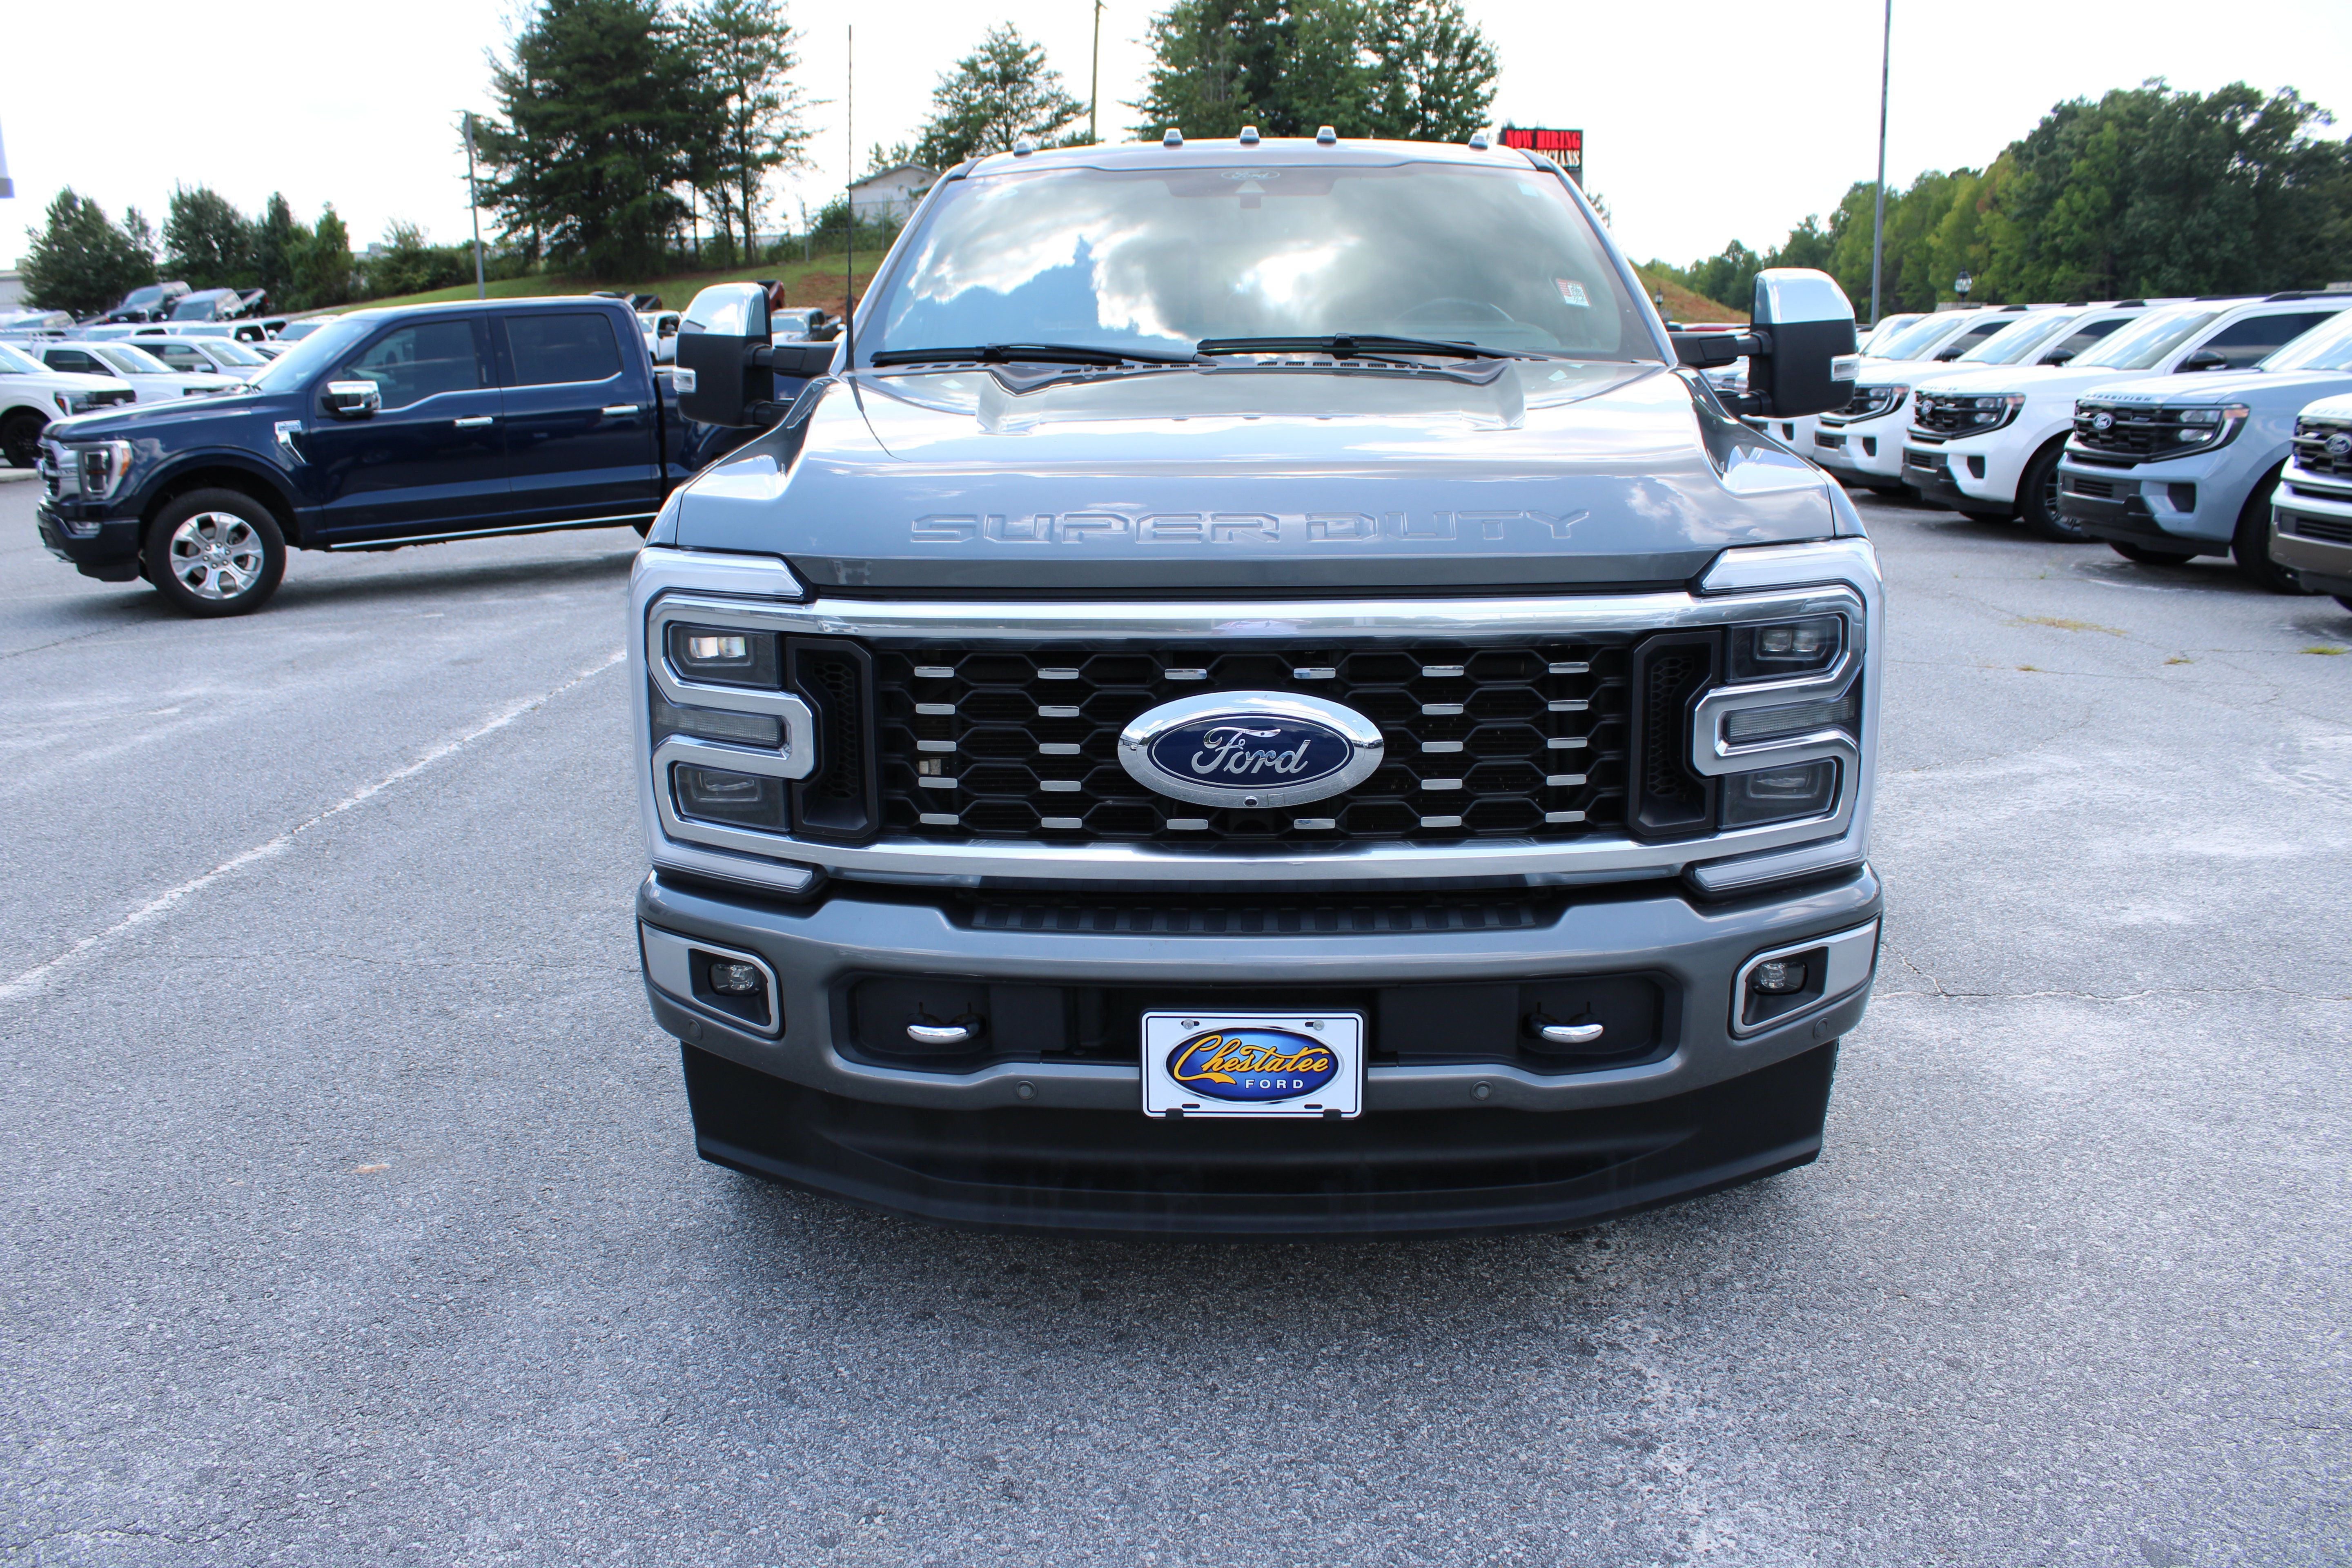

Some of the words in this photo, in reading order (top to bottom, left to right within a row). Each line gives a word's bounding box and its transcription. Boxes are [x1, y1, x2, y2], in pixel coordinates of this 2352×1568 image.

[1506, 130, 1534, 148] NOW
[1537, 130, 1580, 149] HIRING
[911, 513, 1281, 544] SUPER
[1305, 510, 1590, 542] DUTY
[1191, 726, 1311, 774] Ford
[1173, 1034, 1330, 1085] Chestatee
[1245, 1079, 1304, 1089] FORD
